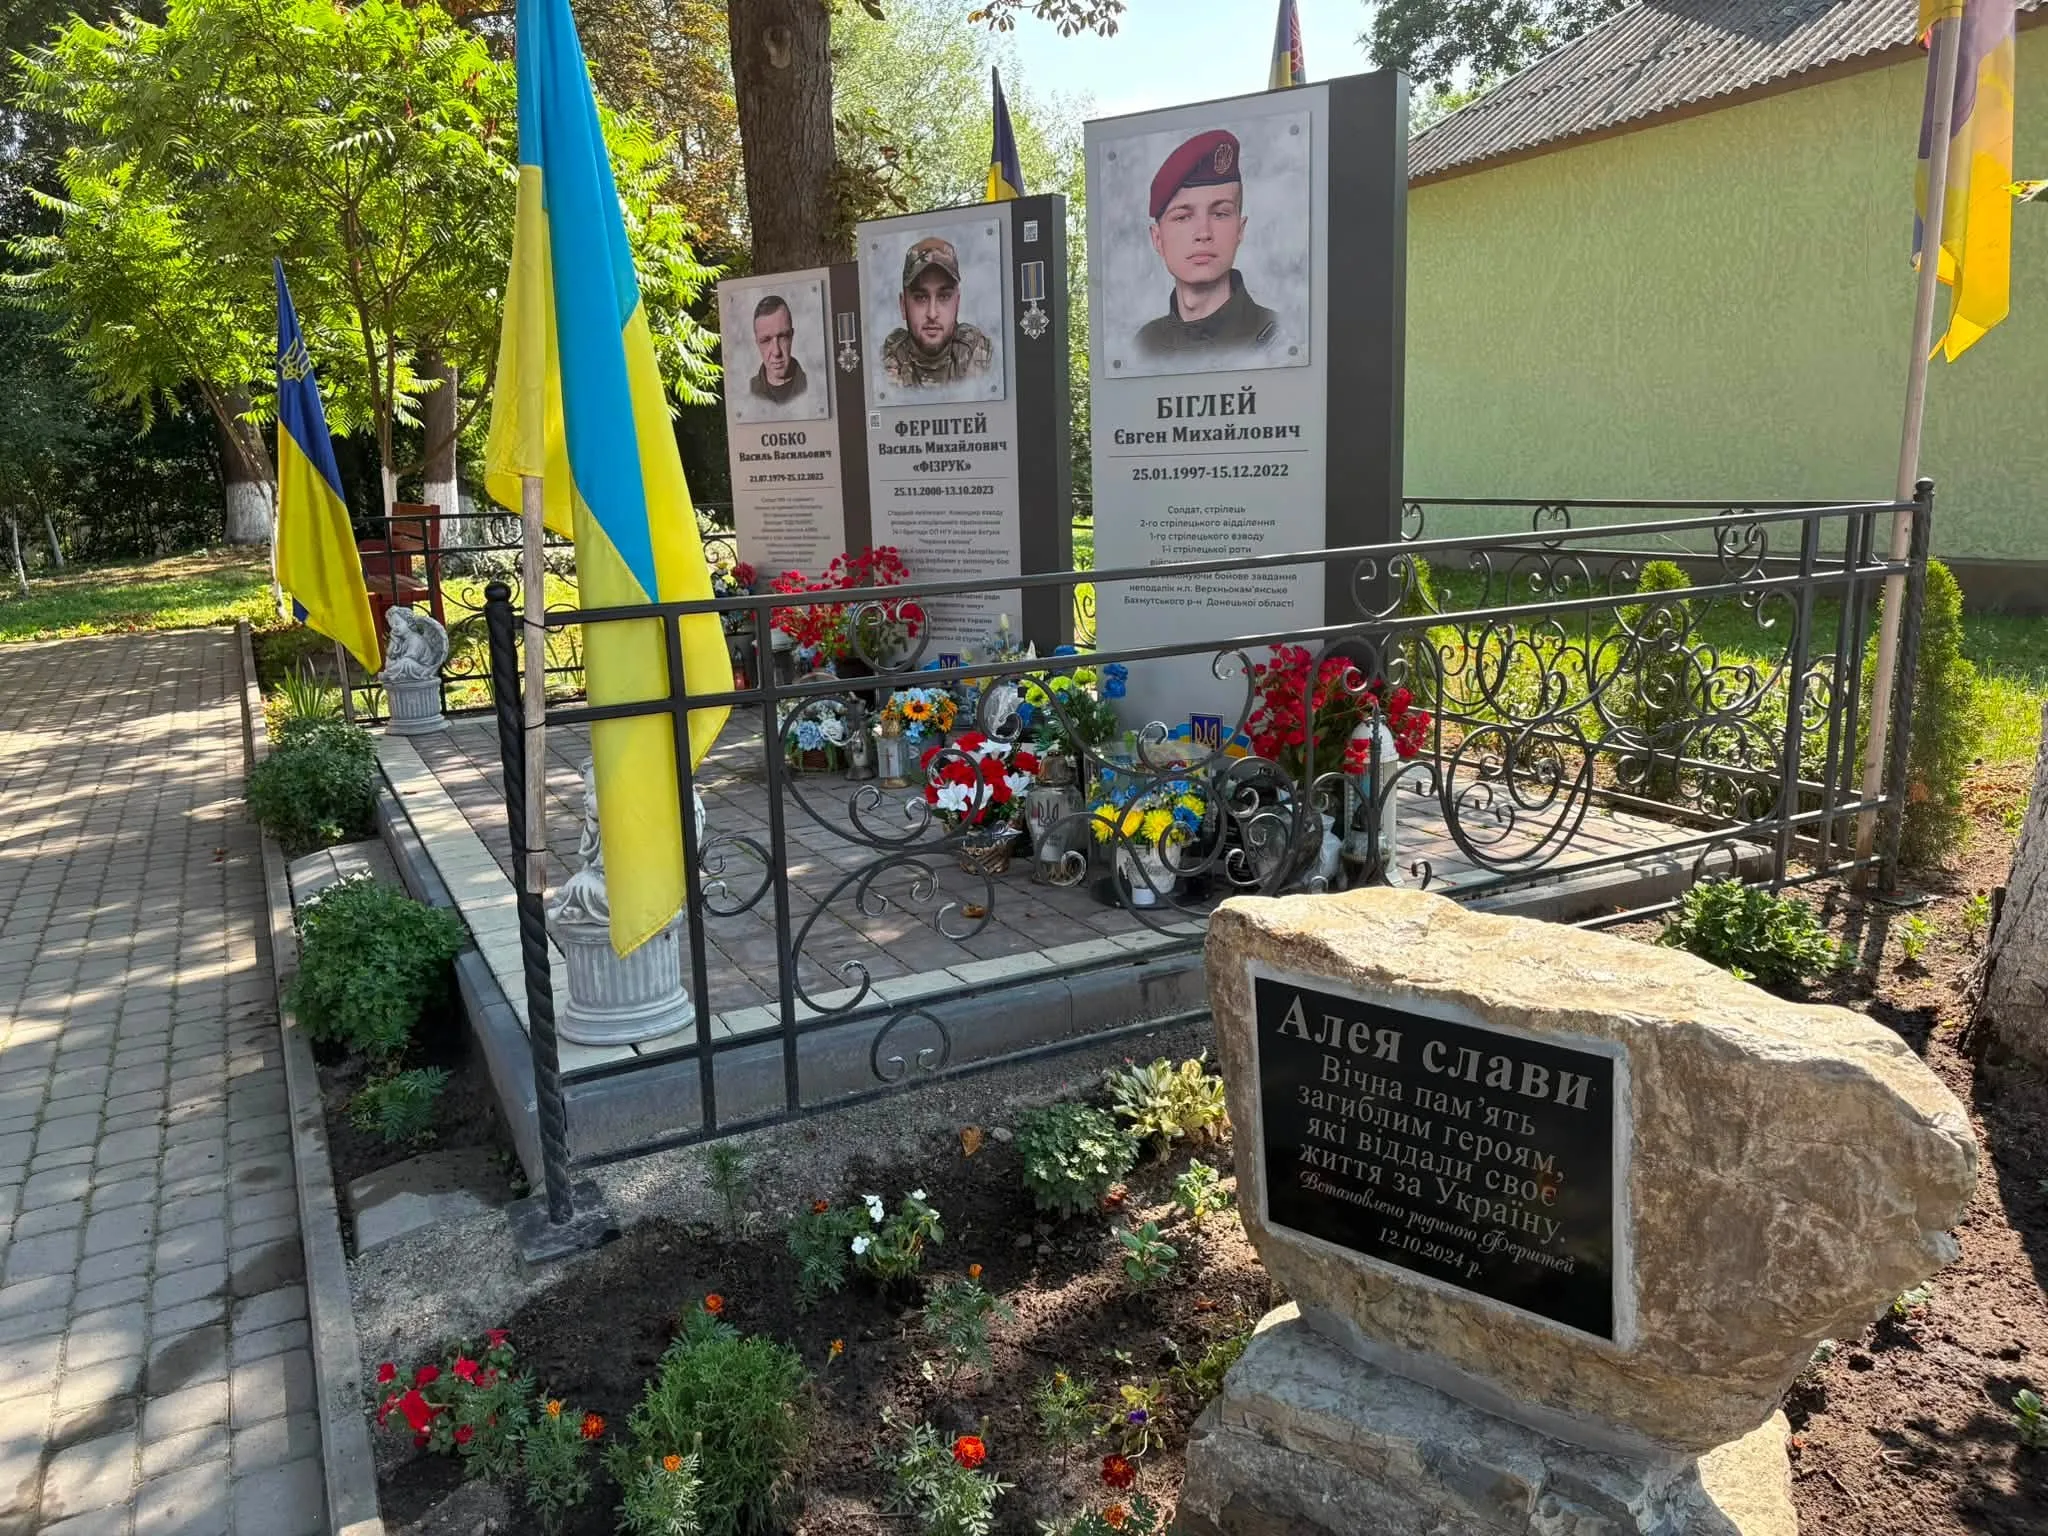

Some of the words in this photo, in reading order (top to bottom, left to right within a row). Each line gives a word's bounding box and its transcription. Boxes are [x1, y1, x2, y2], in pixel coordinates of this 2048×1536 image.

[1157, 386, 1257, 419] БІГЛЕЙ
[895, 412, 987, 437] ФЕРШТЕЙ
[761, 432, 806, 447] СОБКО
[1114, 428, 1167, 445] Євген
[1173, 424, 1301, 443] Михайлович
[879, 443, 922, 455] Василь
[925, 440, 1007, 454] Михайлович
[739, 452, 772, 462] Василь
[774, 450, 832, 460] Васильович
[912, 459, 971, 472] «ФІЗРУК»
[1132, 463, 1289, 481] 25.01.1997-15.12.2022
[1167, 505, 1202, 515] Солдат,
[1204, 504, 1246, 515] стрілець
[1140, 519, 1157, 528] 2-го
[1159, 518, 1220, 529] стрілецького
[1223, 518, 1276, 528] відділення
[1149, 532, 1166, 541] 1-го
[1168, 531, 1229, 542] стрілецького
[1231, 532, 1265, 542] взводу
[1173, 544, 1227, 555] стрілецької
[1229, 545, 1252, 555] роти
[1214, 571, 1249, 581] бойове
[1251, 572, 1297, 582] завдання
[1129, 584, 1175, 595] неподалік
[1124, 596, 1185, 608] Бахмутського
[1206, 598, 1257, 609] Донецької
[1258, 598, 1294, 609] області
[1277, 994, 1403, 1064] Алея
[1422, 1039, 1593, 1111] слави
[1320, 1055, 1403, 1102] Вічна
[1416, 1087, 1537, 1136] пам’ять
[1297, 1085, 1433, 1140] загиблим
[1444, 1126, 1565, 1184] героям,
[1308, 1117, 1346, 1144] які
[1357, 1130, 1474, 1180] віддали
[1485, 1169, 1559, 1208] своє
[1299, 1143, 1382, 1185] життя
[1392, 1172, 1423, 1198] за
[1435, 1177, 1567, 1246] Україну.
[1299, 1171, 1406, 1218] Встановлено
[1408, 1209, 1479, 1243] родиною
[1378, 1226, 1465, 1267] 12.10.2024
[1467, 1257, 1485, 1279] р.
